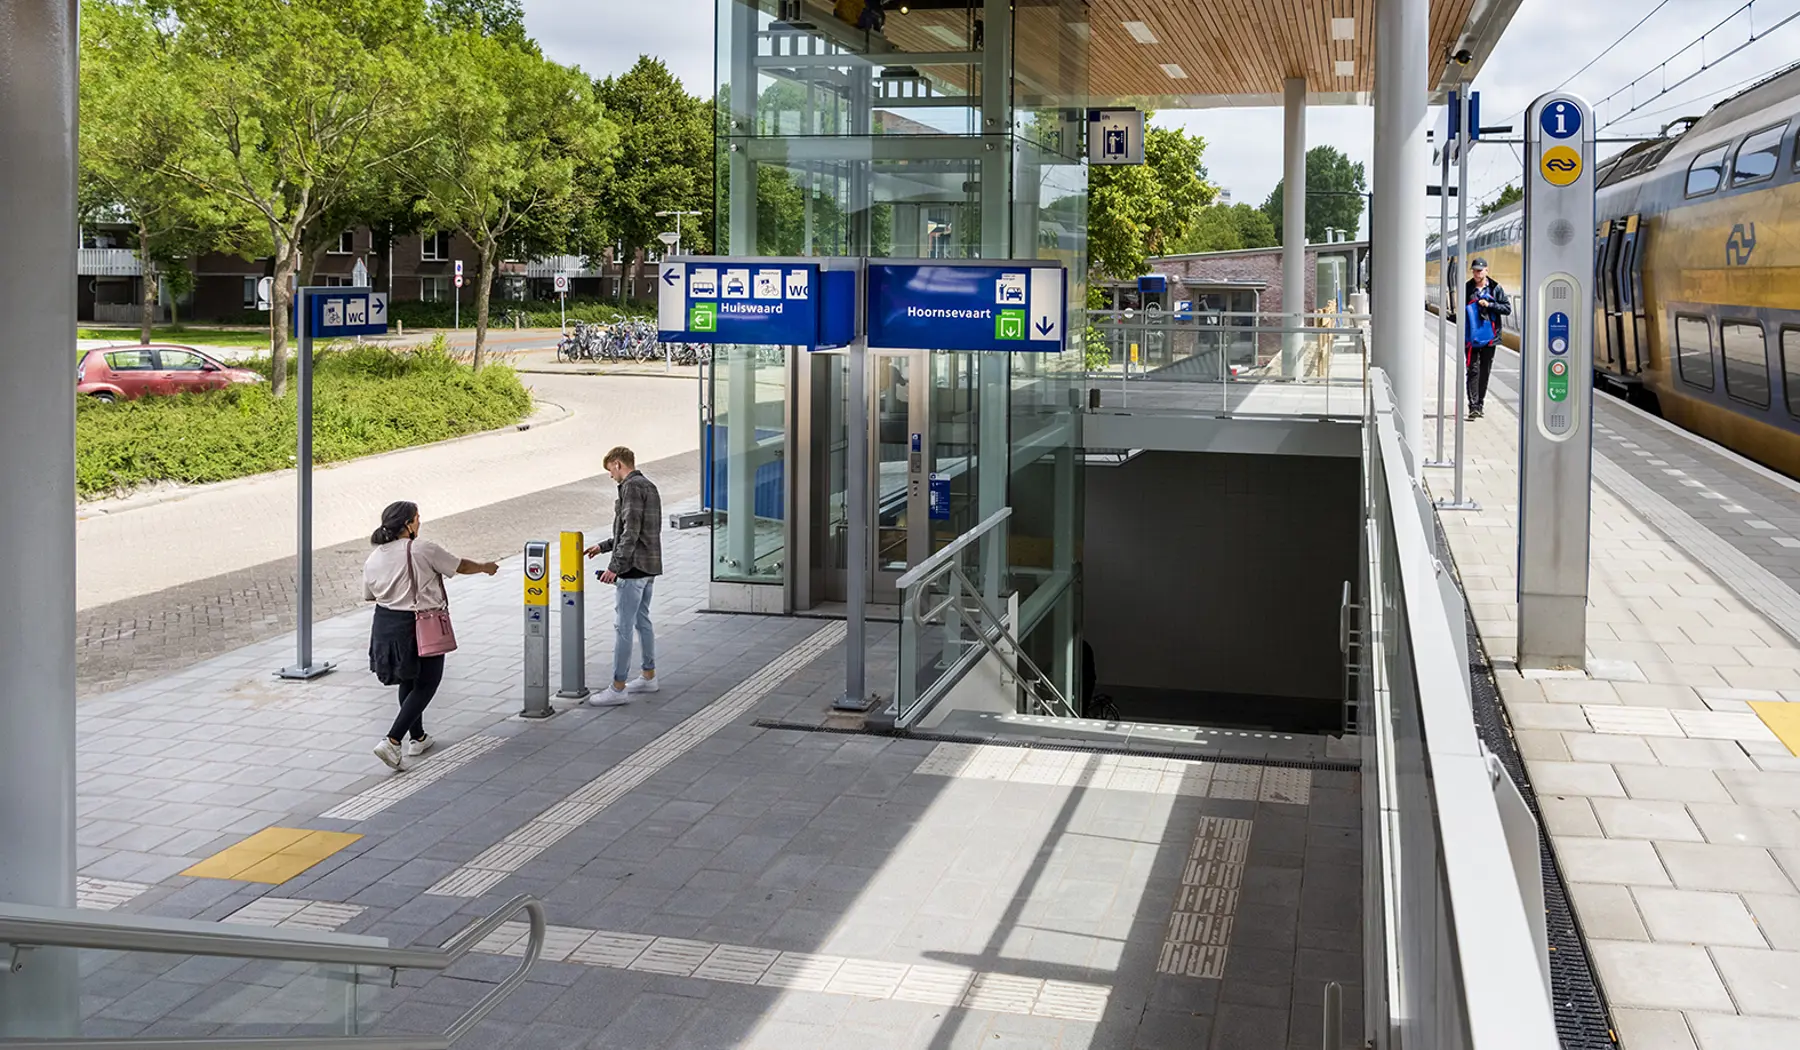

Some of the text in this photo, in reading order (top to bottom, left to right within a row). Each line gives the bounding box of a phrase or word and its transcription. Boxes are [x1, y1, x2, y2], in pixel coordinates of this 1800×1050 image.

[721, 302, 783, 314] Huiswaard
[907, 306, 991, 319] Hoornsevaart
[348, 312, 364, 323] WC
